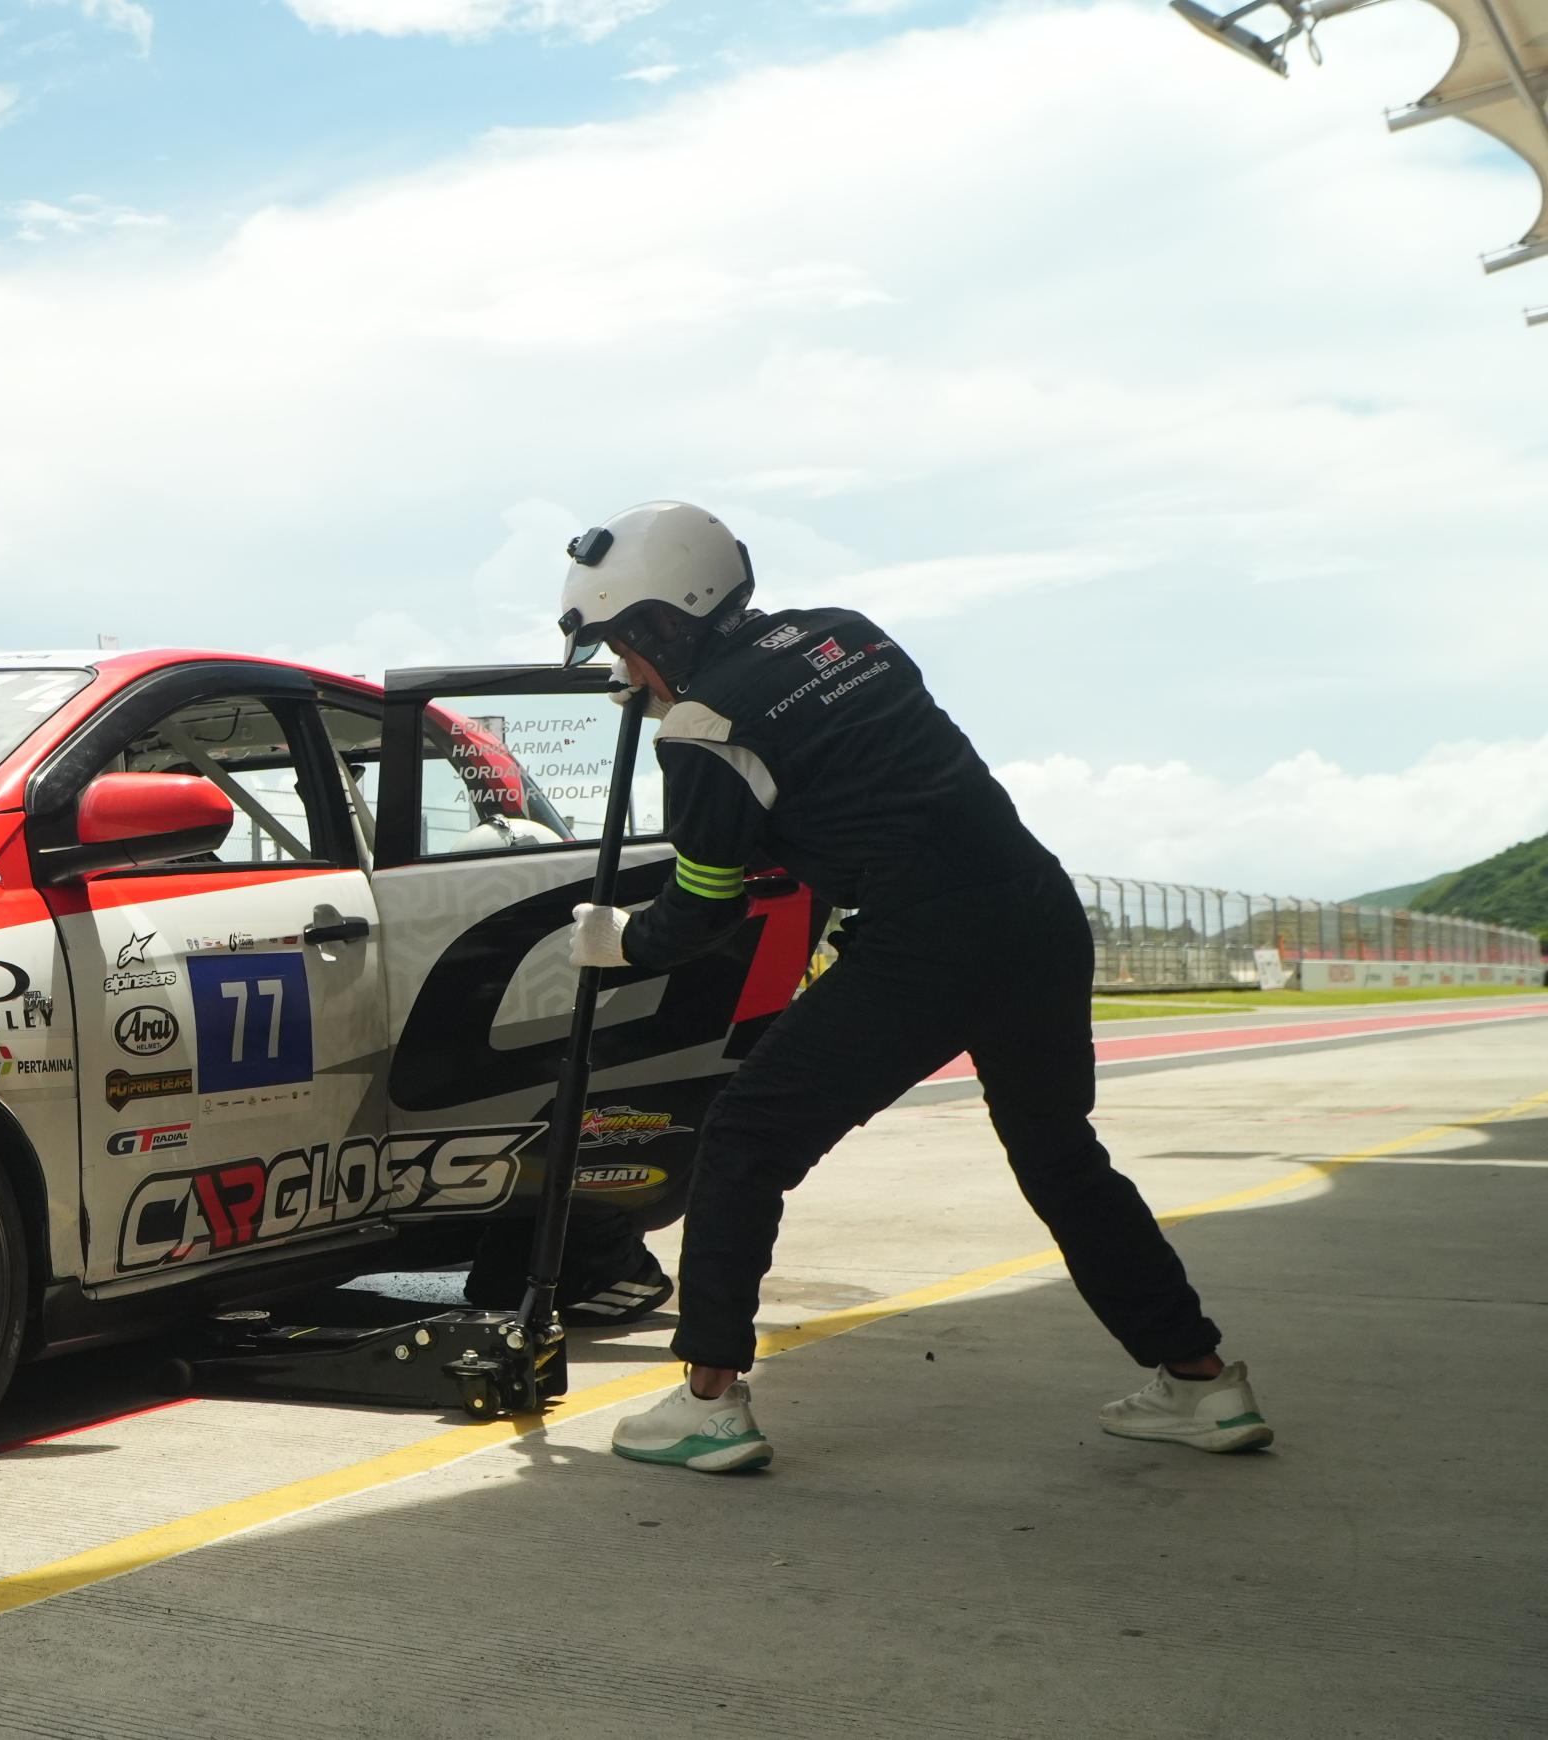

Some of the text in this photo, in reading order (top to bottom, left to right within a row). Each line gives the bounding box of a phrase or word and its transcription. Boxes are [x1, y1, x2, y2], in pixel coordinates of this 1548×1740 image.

[760, 625, 799, 648] OMP
[812, 646, 843, 670] GR
[765, 677, 821, 720] TOYOTA
[820, 651, 865, 680] GAZOO
[820, 660, 890, 705] Indonesia
[501, 719, 586, 734] SAPUTRA
[453, 764, 530, 780] JORDAN
[535, 763, 599, 777] JOHAN
[454, 788, 519, 803] AMATO
[104, 970, 177, 995] alpinestars
[120, 1010, 172, 1043] Arai
[220, 979, 283, 1063] 77
[136, 1042, 161, 1050] HELMET
[17, 1058, 74, 1074] PERTAMINA
[128, 1080, 160, 1093] PRIME
[161, 1078, 191, 1090] GEARS
[153, 1132, 188, 1143] RADIAL
[578, 1168, 649, 1182] SEJATI
[116, 1122, 545, 1275] CARGLOSS
